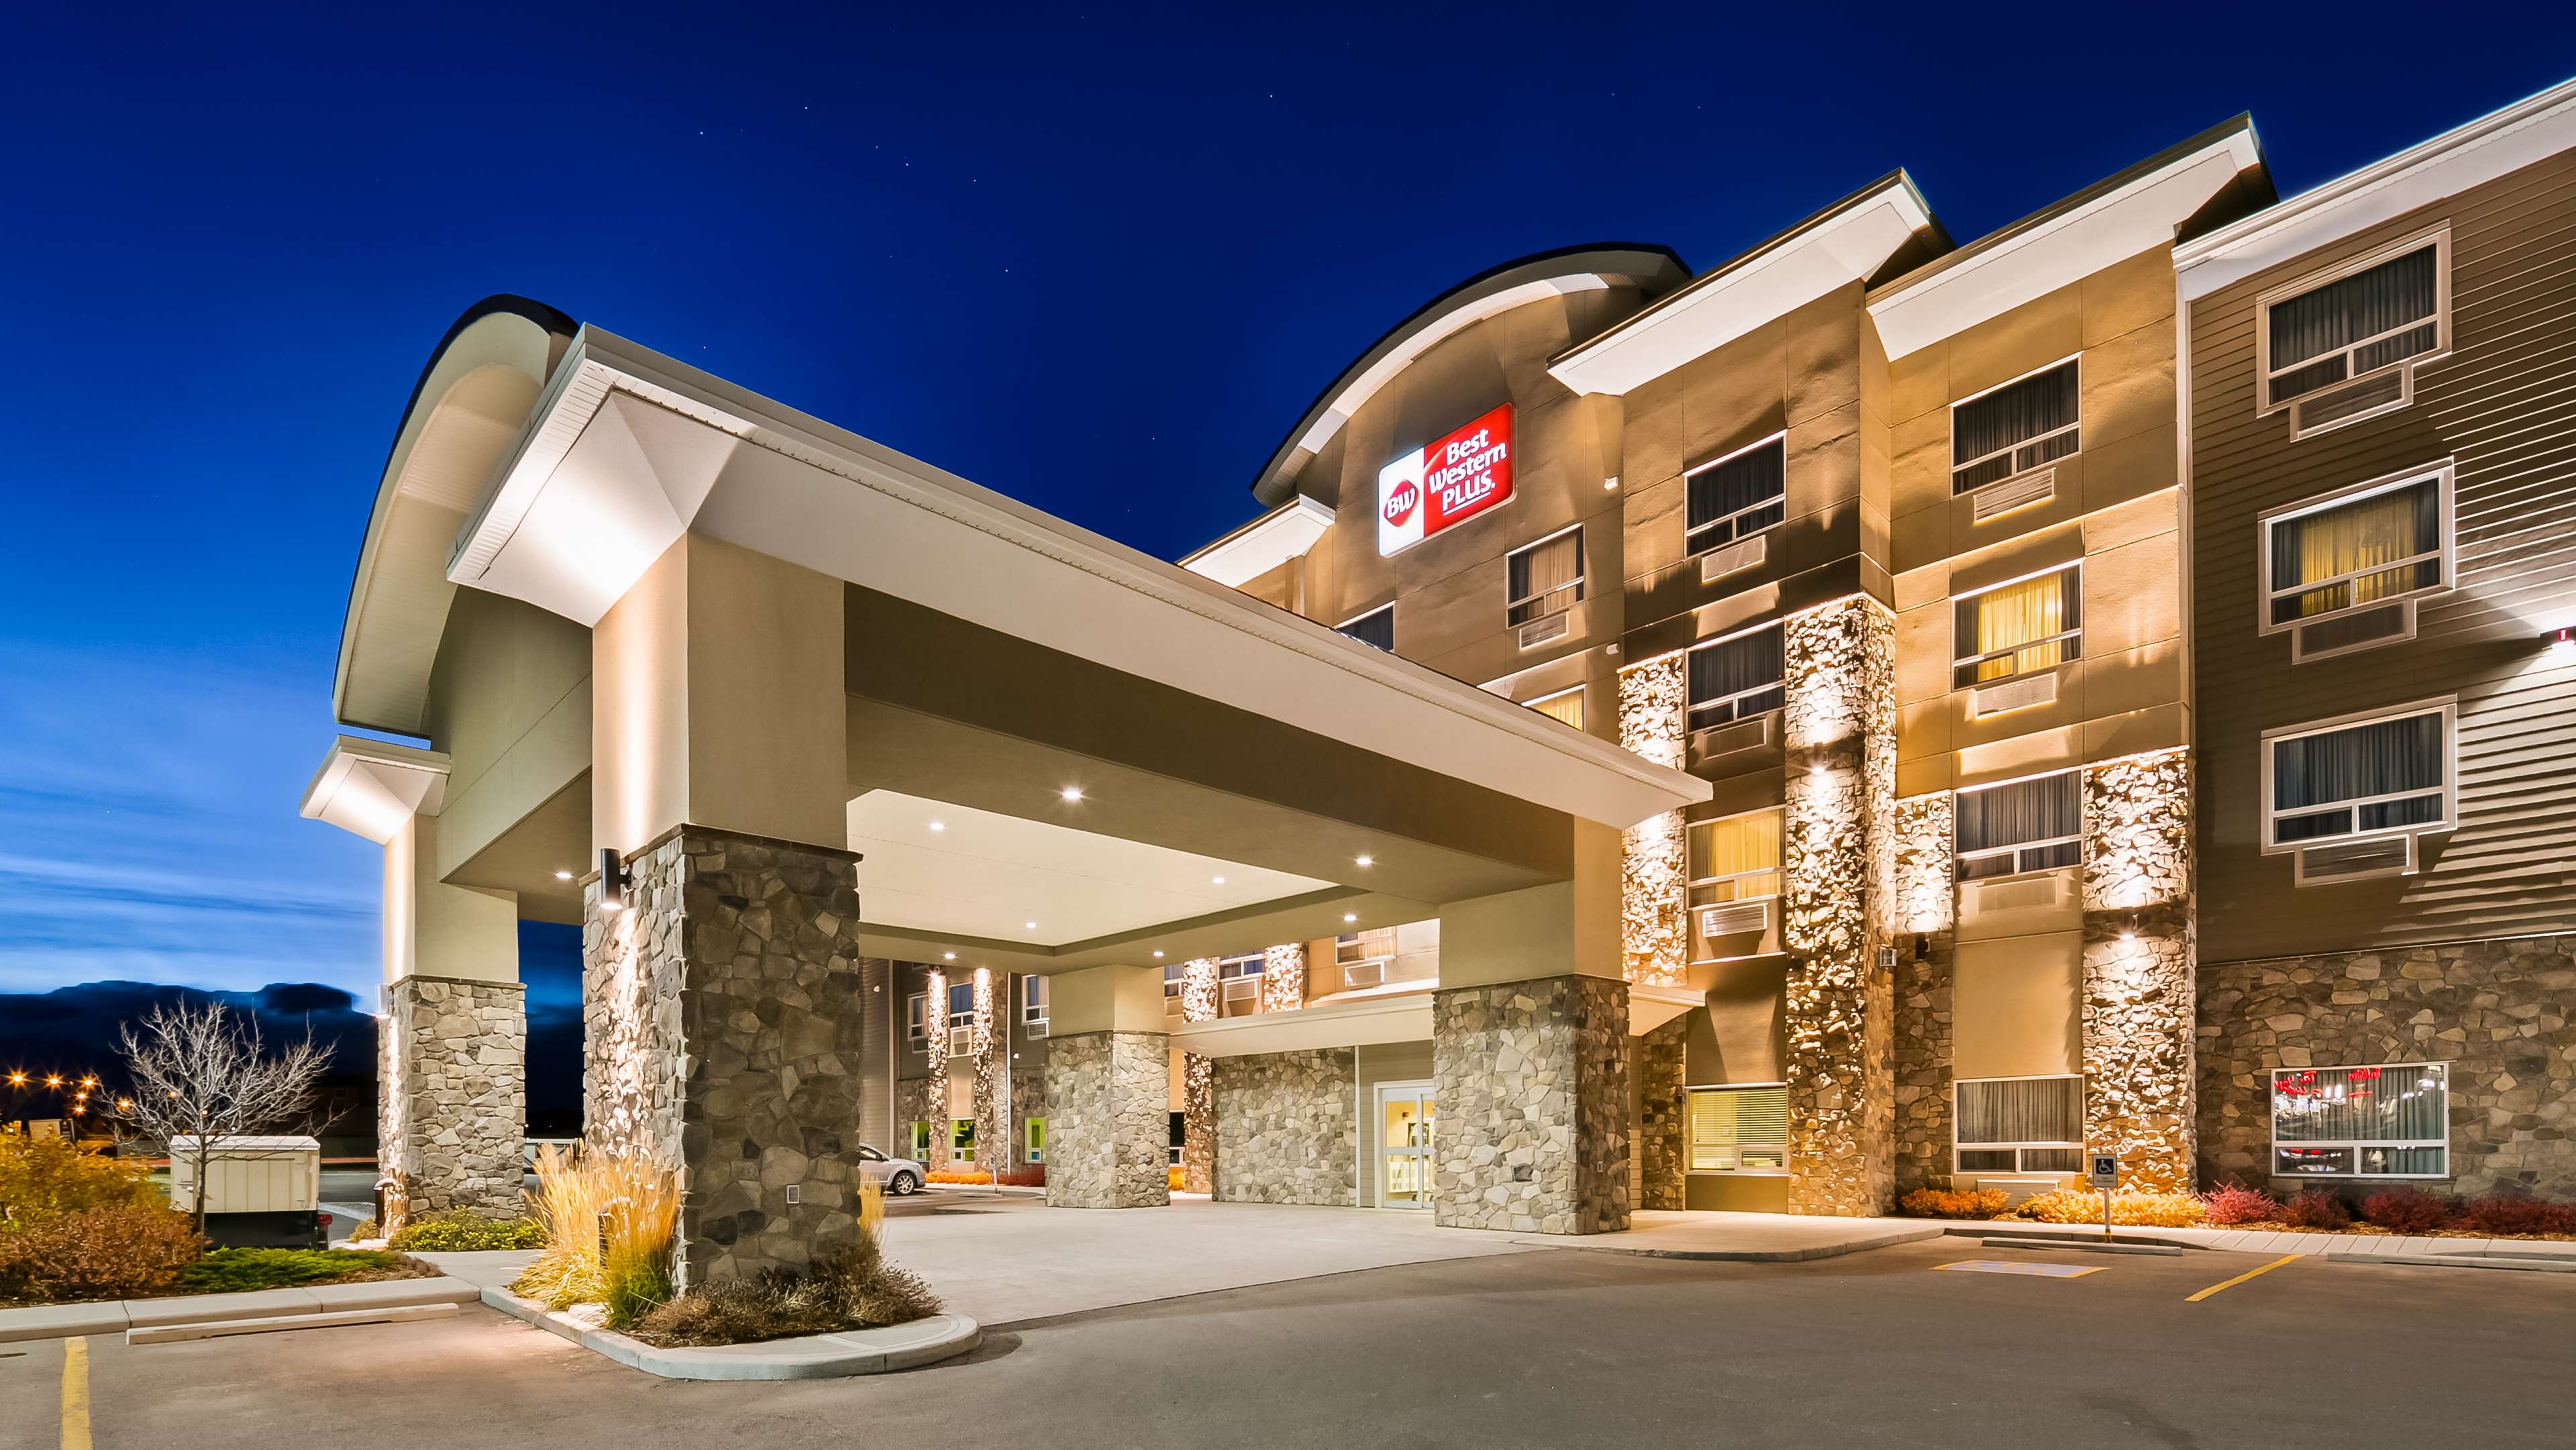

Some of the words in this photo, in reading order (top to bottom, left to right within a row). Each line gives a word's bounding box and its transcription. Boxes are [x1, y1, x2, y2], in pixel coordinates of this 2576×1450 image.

[1447, 429, 1489, 466] Best
[1429, 442, 1507, 495] Western
[1387, 488, 1416, 519] BW
